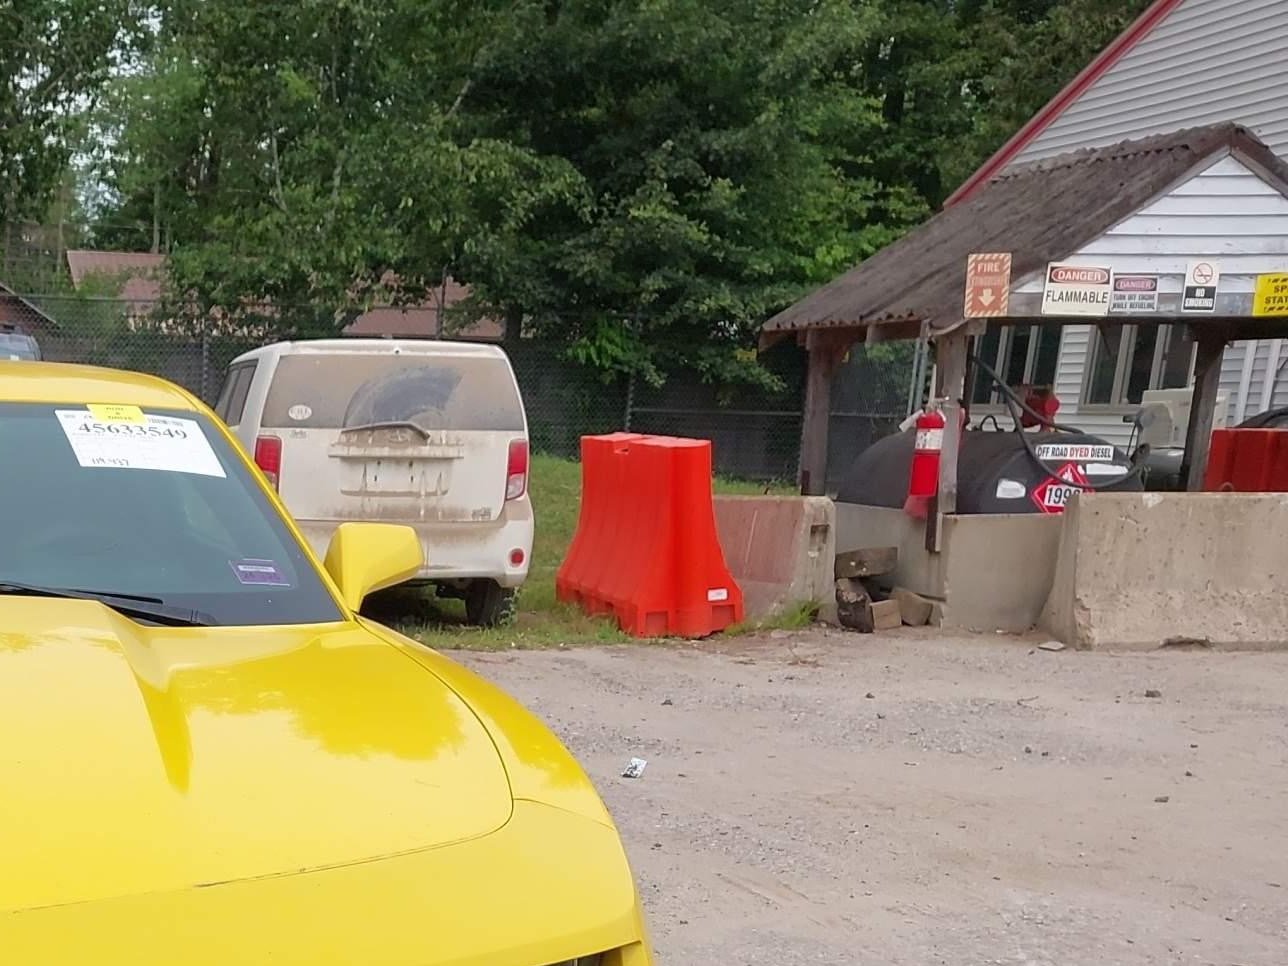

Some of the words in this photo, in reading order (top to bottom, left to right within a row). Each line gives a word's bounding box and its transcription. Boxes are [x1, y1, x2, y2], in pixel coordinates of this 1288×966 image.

[977, 262, 1000, 273] FIRE
[1057, 270, 1101, 281] DANGER
[1119, 280, 1152, 289] DANGER
[1046, 290, 1108, 304] FLAMMABLE
[79, 423, 187, 439] 45633549
[1037, 447, 1050, 457] OFF
[1052, 447, 1068, 457] ROAD
[1069, 447, 1089, 457] DYED
[1090, 447, 1111, 458] DIESEL
